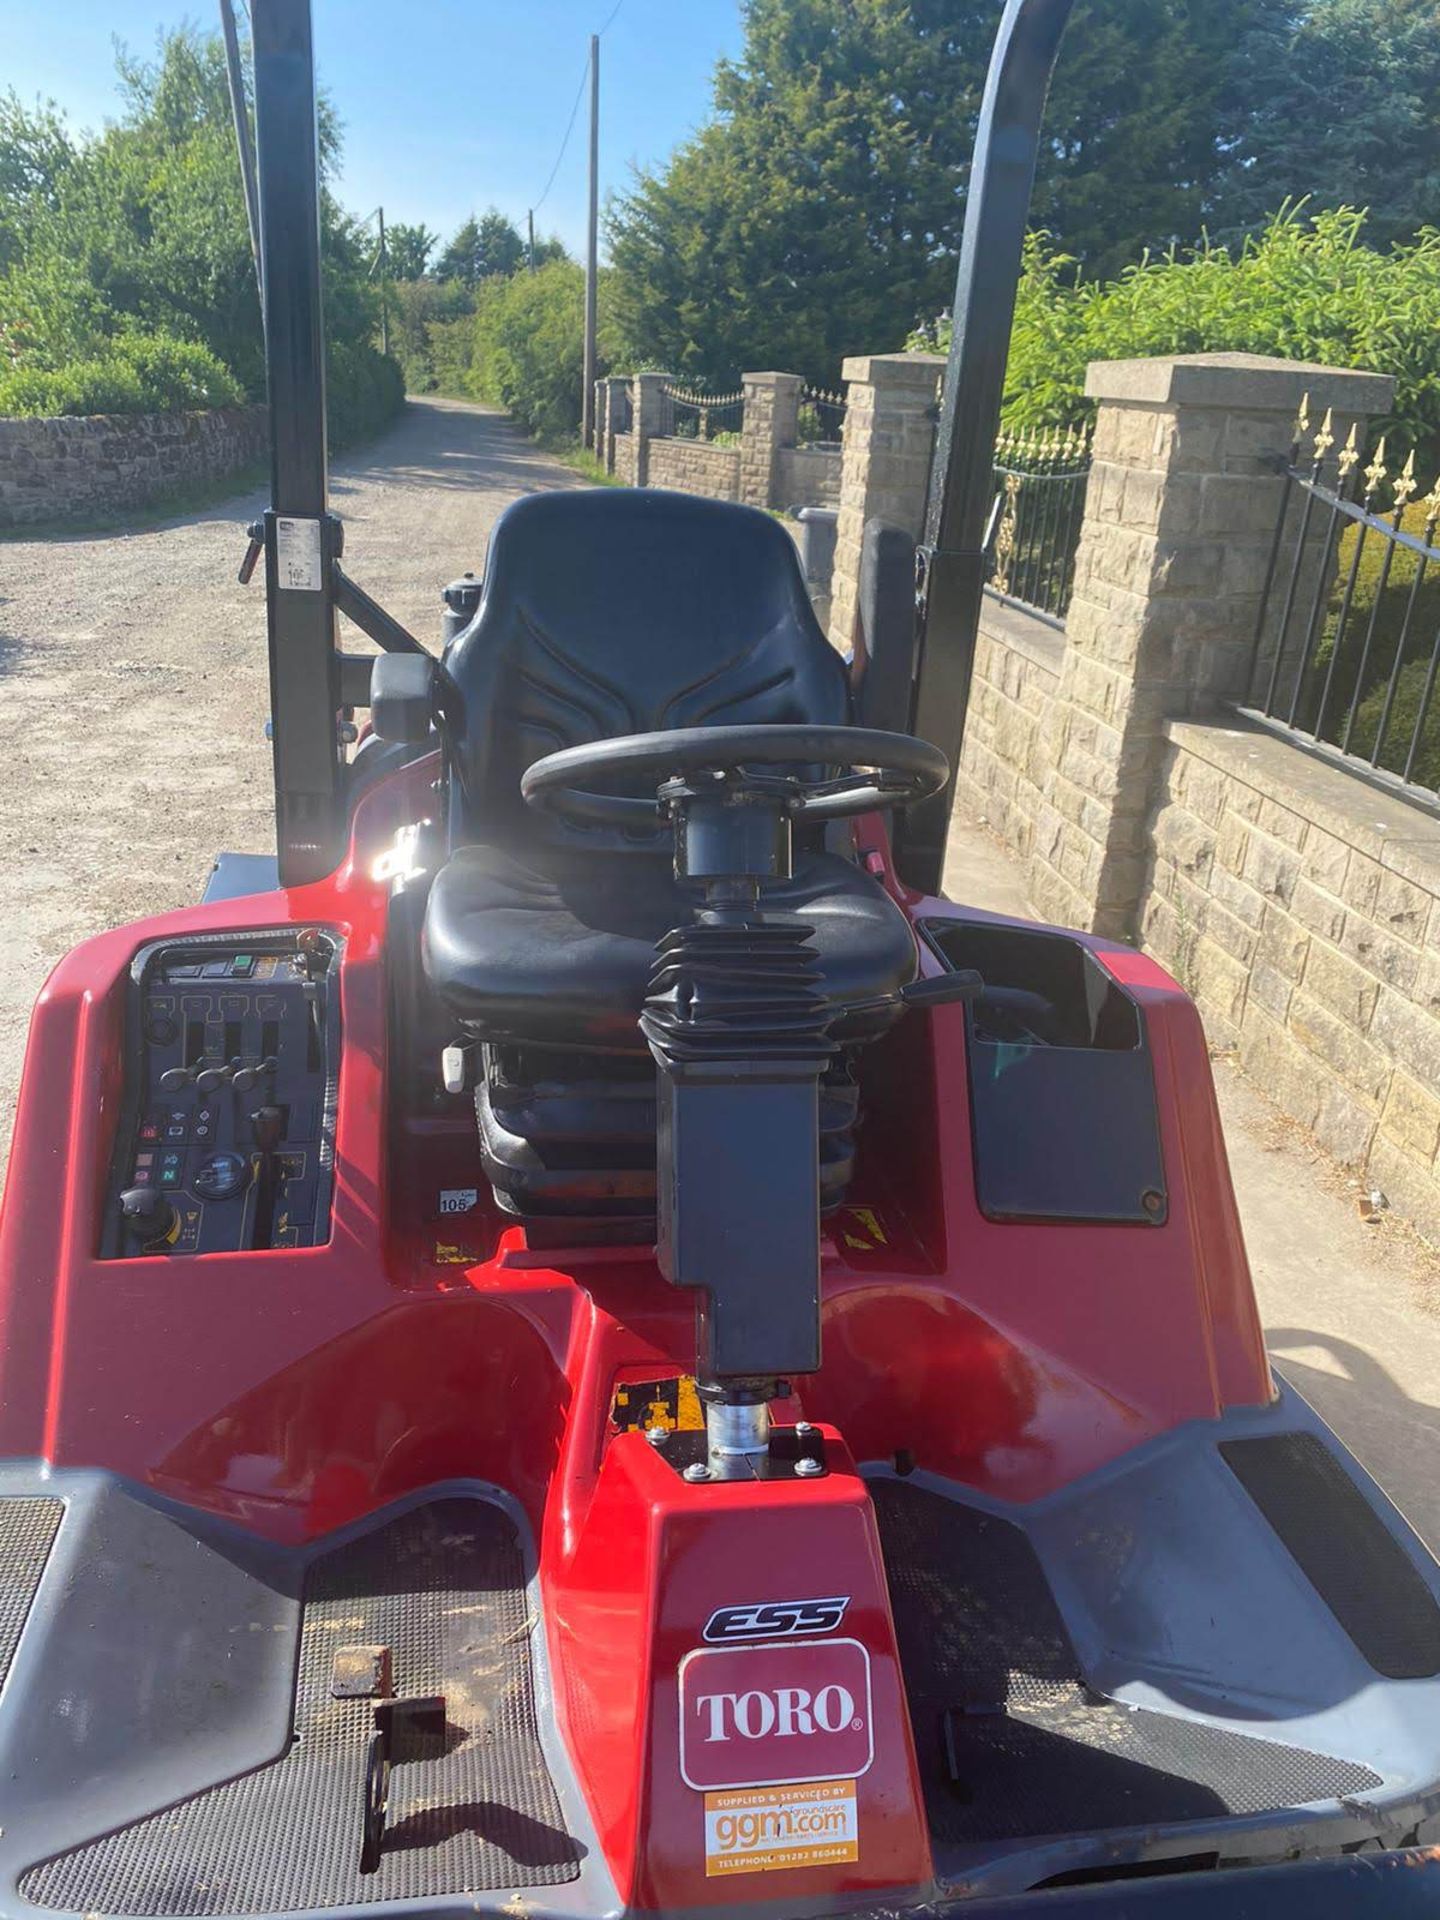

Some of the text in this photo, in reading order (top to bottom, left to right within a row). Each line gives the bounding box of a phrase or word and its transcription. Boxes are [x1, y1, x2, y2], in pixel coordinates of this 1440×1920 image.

[442, 1199, 466, 1211] 105
[704, 1598, 849, 1640] ESS
[717, 1795, 765, 1807] SUPPLIED
[768, 1794, 777, 1803] &
[832, 1786, 846, 1796] BY
[716, 1810, 847, 1850] ggm.com
